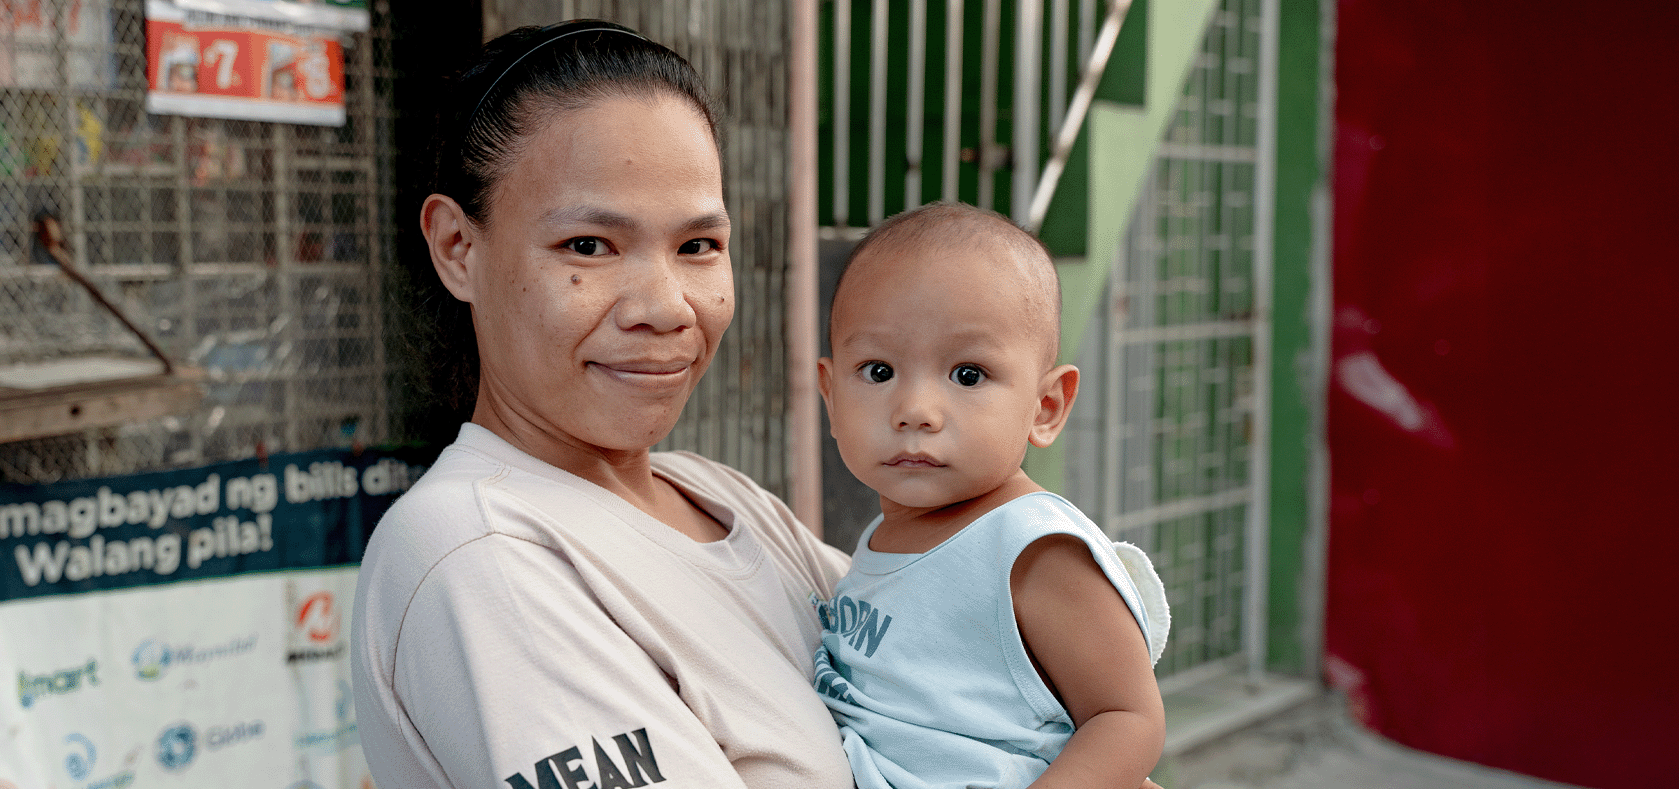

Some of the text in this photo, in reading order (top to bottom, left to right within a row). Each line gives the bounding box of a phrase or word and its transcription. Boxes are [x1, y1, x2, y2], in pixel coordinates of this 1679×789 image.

[0, 474, 221, 539] magbayad
[226, 475, 278, 513] ng
[284, 463, 359, 503] bills
[14, 513, 274, 587] Walang pila!
[503, 727, 667, 789] MEAN
